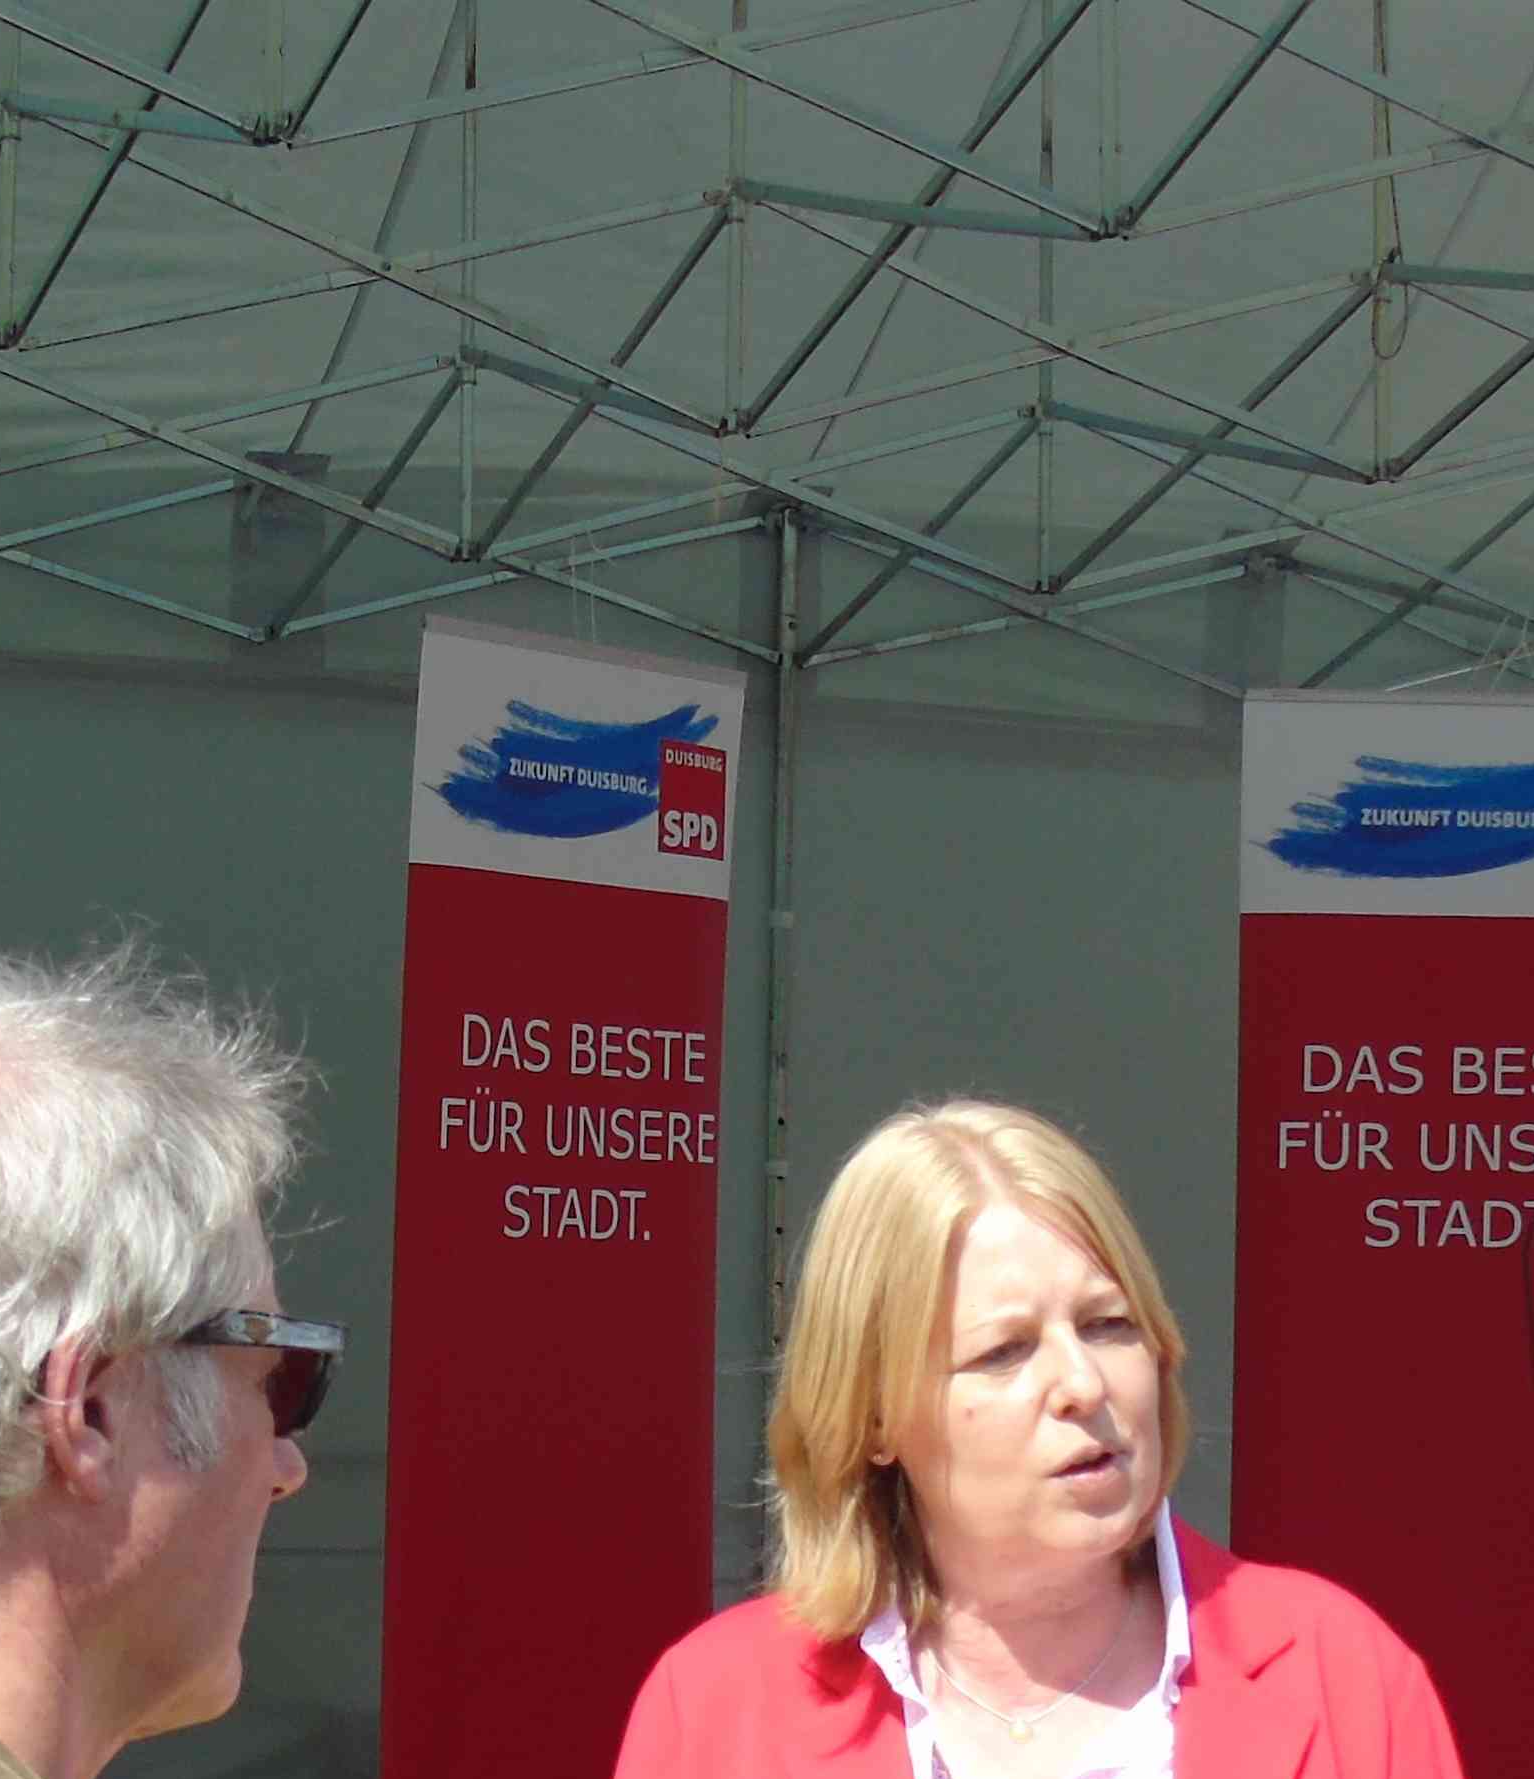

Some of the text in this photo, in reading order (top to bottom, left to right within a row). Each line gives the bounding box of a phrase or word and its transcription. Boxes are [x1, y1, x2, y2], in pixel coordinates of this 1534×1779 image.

[509, 757, 647, 795] ZUKUNFT DUISBURG
[665, 748, 723, 772] DUISBURG
[663, 809, 718, 852] SPD
[1360, 807, 1451, 828] ZUKUNFT
[462, 1013, 706, 1083] DAS BESTE
[1303, 1044, 1424, 1095] DAS
[439, 1087, 716, 1164] FÜR UNSERE
[1277, 1109, 1393, 1171] FÜR
[503, 1185, 651, 1241] STADT.
